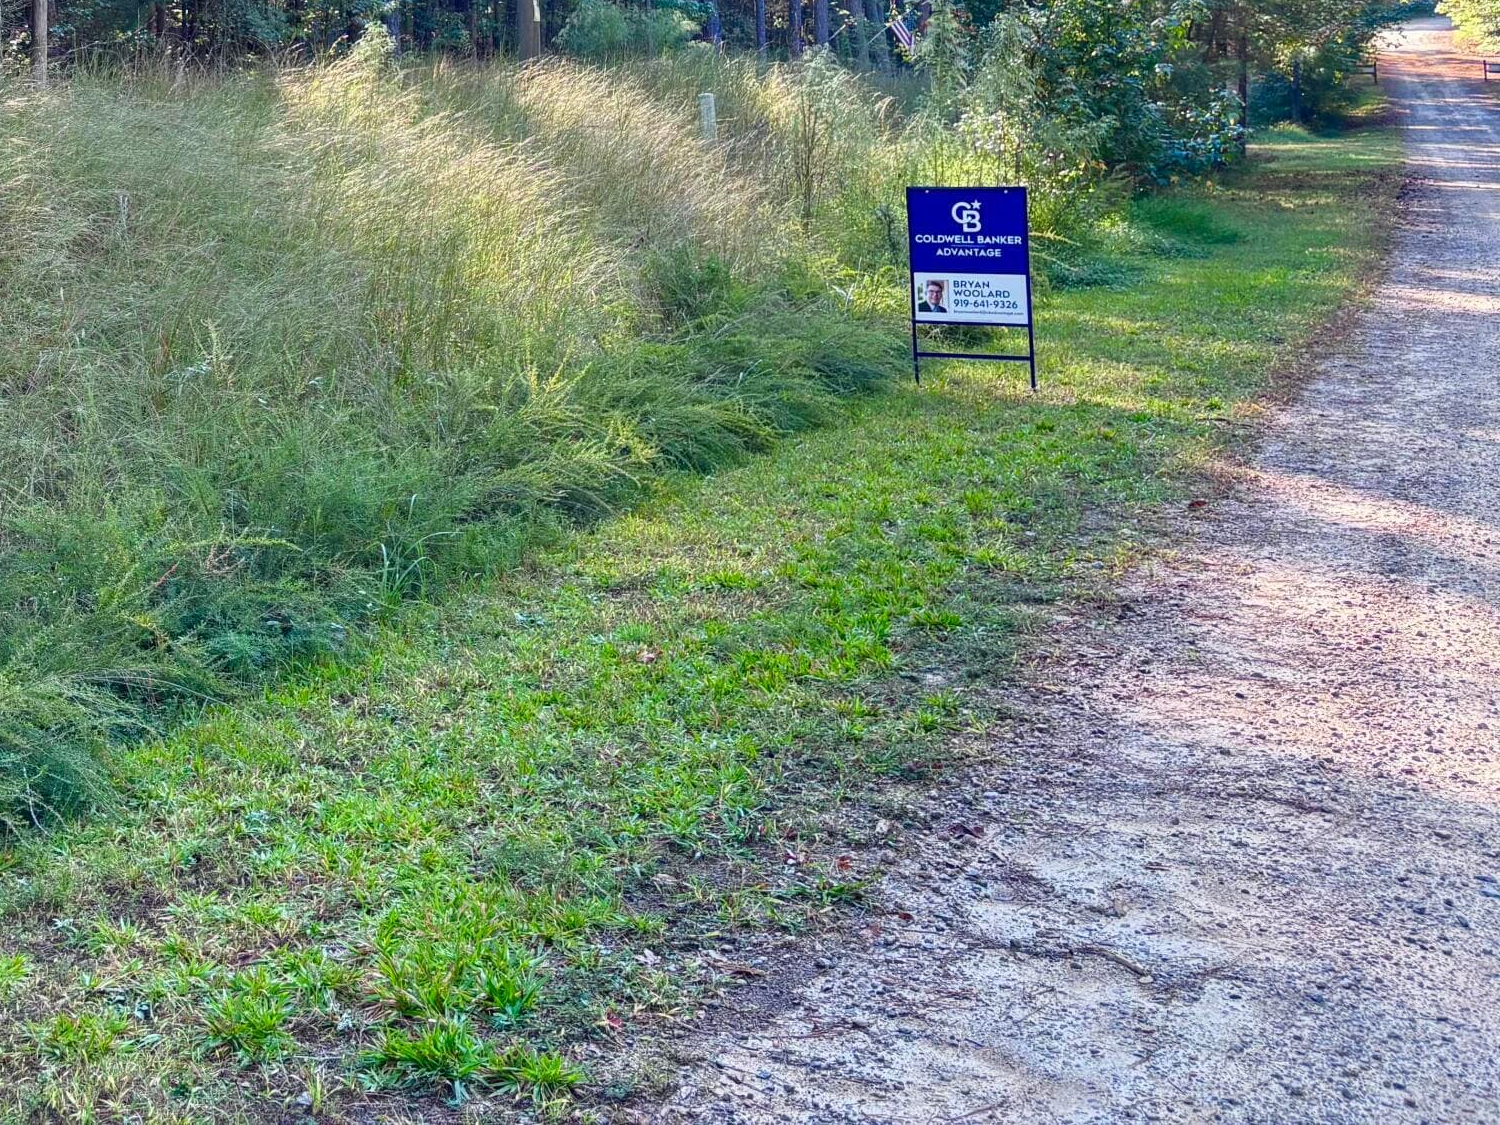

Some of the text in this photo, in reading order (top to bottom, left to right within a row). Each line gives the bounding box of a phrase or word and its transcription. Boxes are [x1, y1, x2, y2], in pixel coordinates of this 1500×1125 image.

[915, 234, 1022, 245] COLDWELL BANKER
[936, 247, 1002, 257] ADVANTAGE
[953, 280, 990, 289] BRYAN
[953, 289, 1011, 299] WOOLARD
[953, 299, 1018, 309] 919-641-9326
